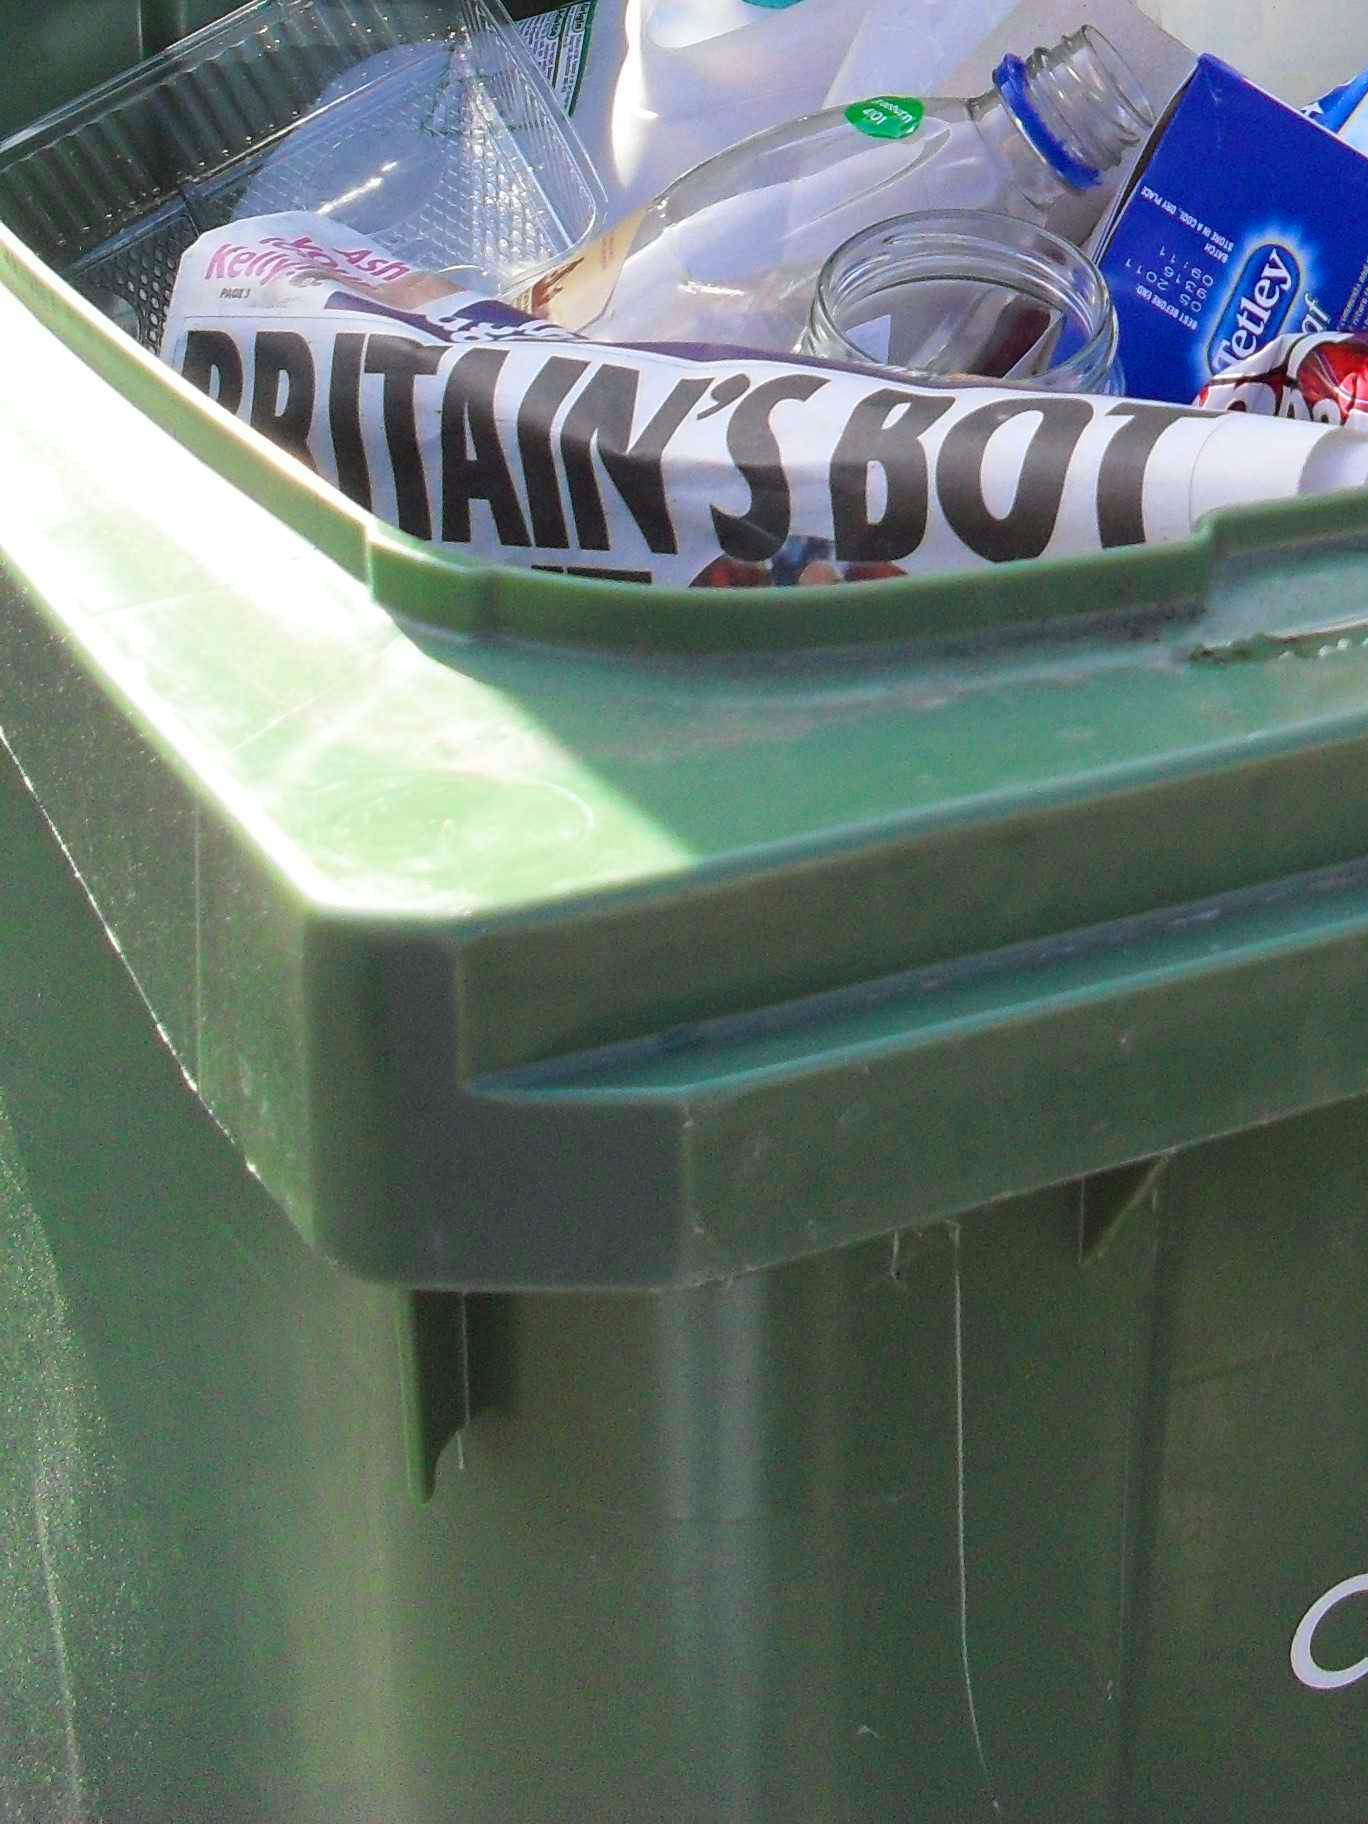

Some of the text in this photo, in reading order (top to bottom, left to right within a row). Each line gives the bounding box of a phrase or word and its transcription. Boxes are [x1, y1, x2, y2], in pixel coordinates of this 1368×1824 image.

[1141, 186, 1162, 205] PLACE
[1162, 200, 1176, 214] DRY
[1211, 232, 1233, 251] STORE
[1204, 244, 1228, 263] BATCH
[1126, 259, 1168, 290] 2011
[1152, 295, 1179, 317] BEFORE
[1212, 247, 1293, 371] Tetley
[1179, 313, 1197, 329] BEST
